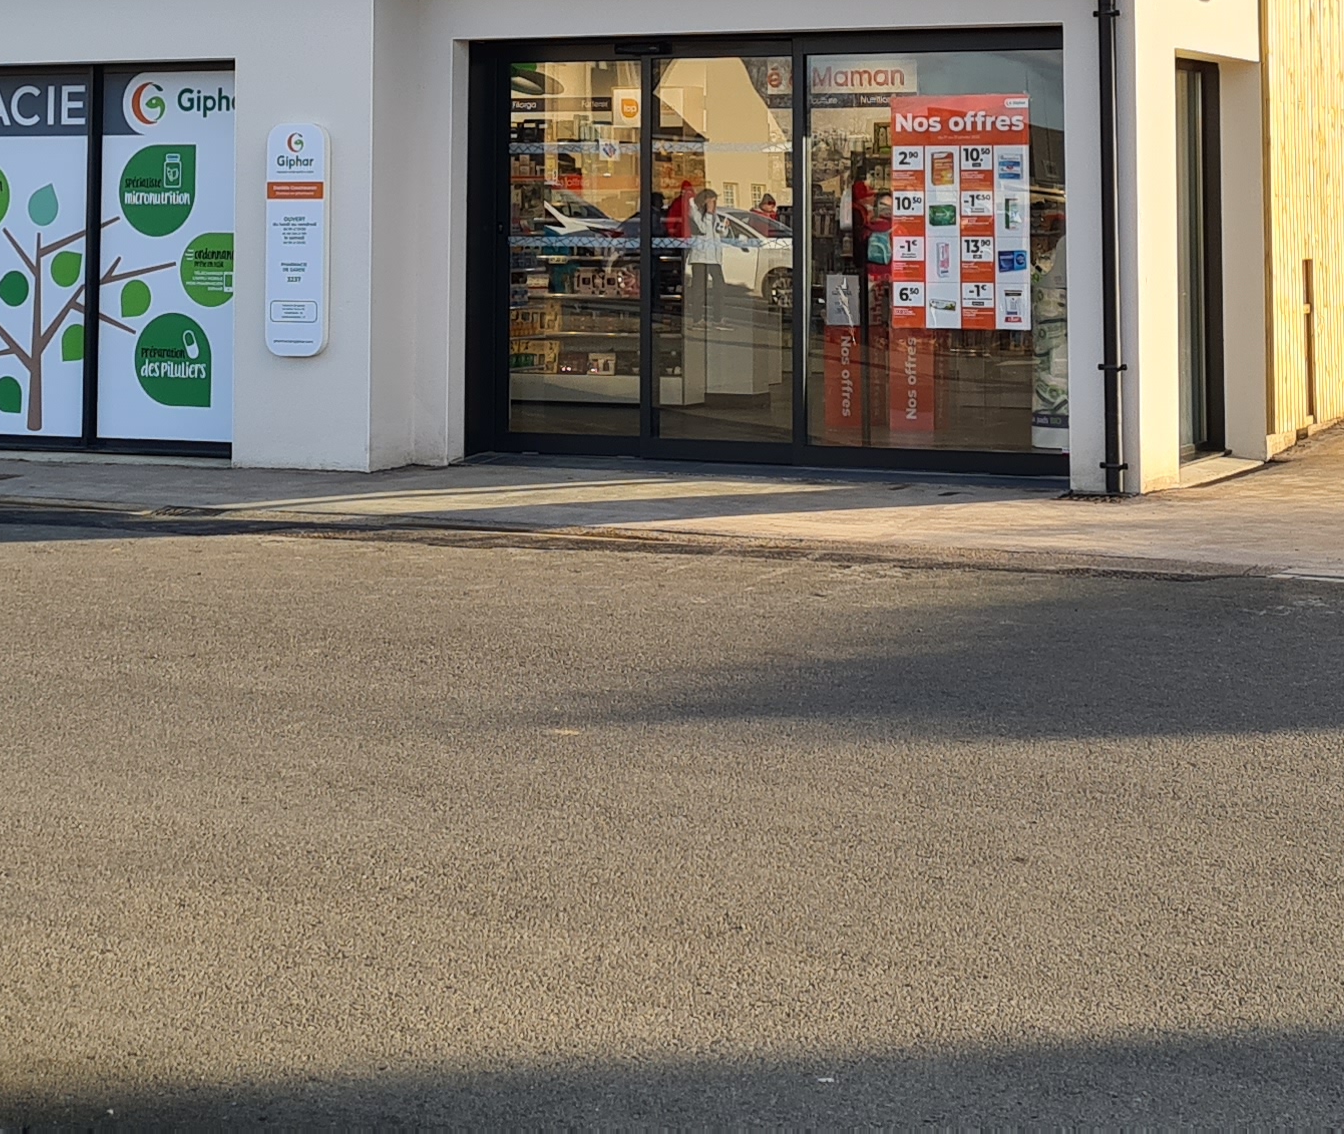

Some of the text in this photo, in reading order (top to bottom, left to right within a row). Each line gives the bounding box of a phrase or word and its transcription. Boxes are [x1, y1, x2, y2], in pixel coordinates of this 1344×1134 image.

[812, 66, 905, 87] Maman
[177, 87, 235, 118] Giph
[860, 95, 890, 104] Nutritio
[895, 110, 1025, 132] Nos offres
[276, 155, 314, 169] Giphar
[124, 191, 191, 205] micronutrition
[194, 247, 234, 260] ordonnan
[140, 359, 159, 377] des
[841, 335, 852, 417] Nos offres
[904, 337, 917, 420] Nos offres
